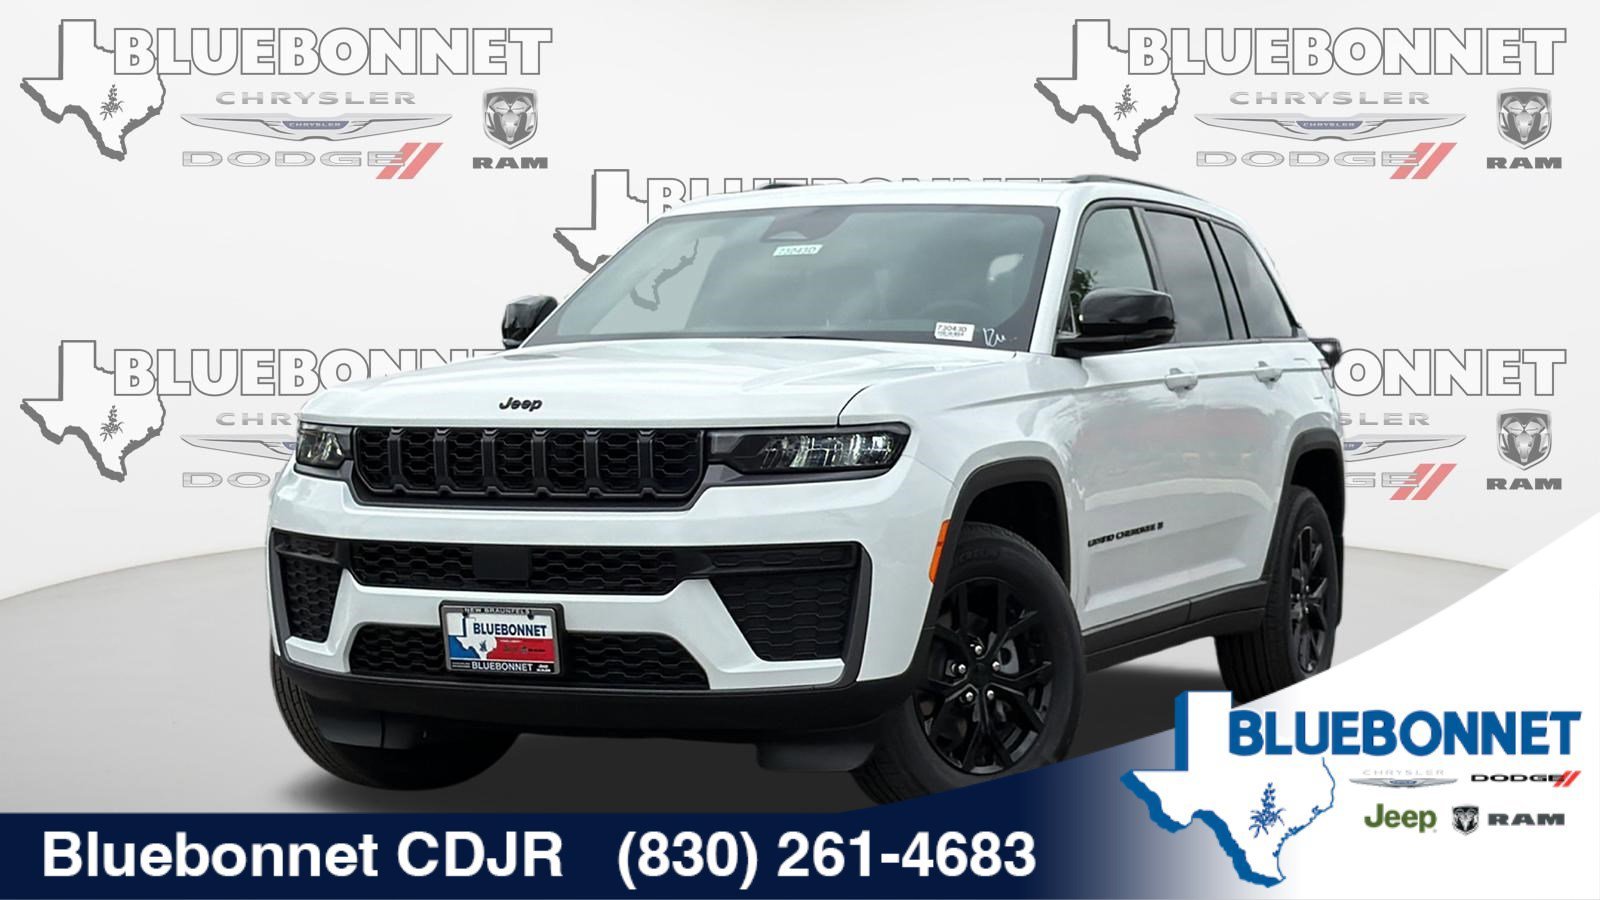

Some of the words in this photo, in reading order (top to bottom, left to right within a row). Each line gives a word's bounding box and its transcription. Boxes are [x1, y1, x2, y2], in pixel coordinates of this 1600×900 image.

[113, 27, 553, 76] BLUEBONNET
[1127, 27, 1567, 76] BLUEBONNET
[215, 91, 416, 105] CHRYSLER
[1229, 91, 1430, 105] CHRYSLER
[182, 150, 405, 167] DODGE
[472, 157, 548, 169] RAM
[1195, 150, 1419, 167] DODGE
[1486, 157, 1562, 169] RAM
[1333, 348, 1567, 396] ONNET
[499, 397, 543, 412] Jeep
[1486, 478, 1562, 490] RAM
[473, 623, 547, 637] BLUEBONNET
[472, 661, 533, 672] BLUEBONNET
